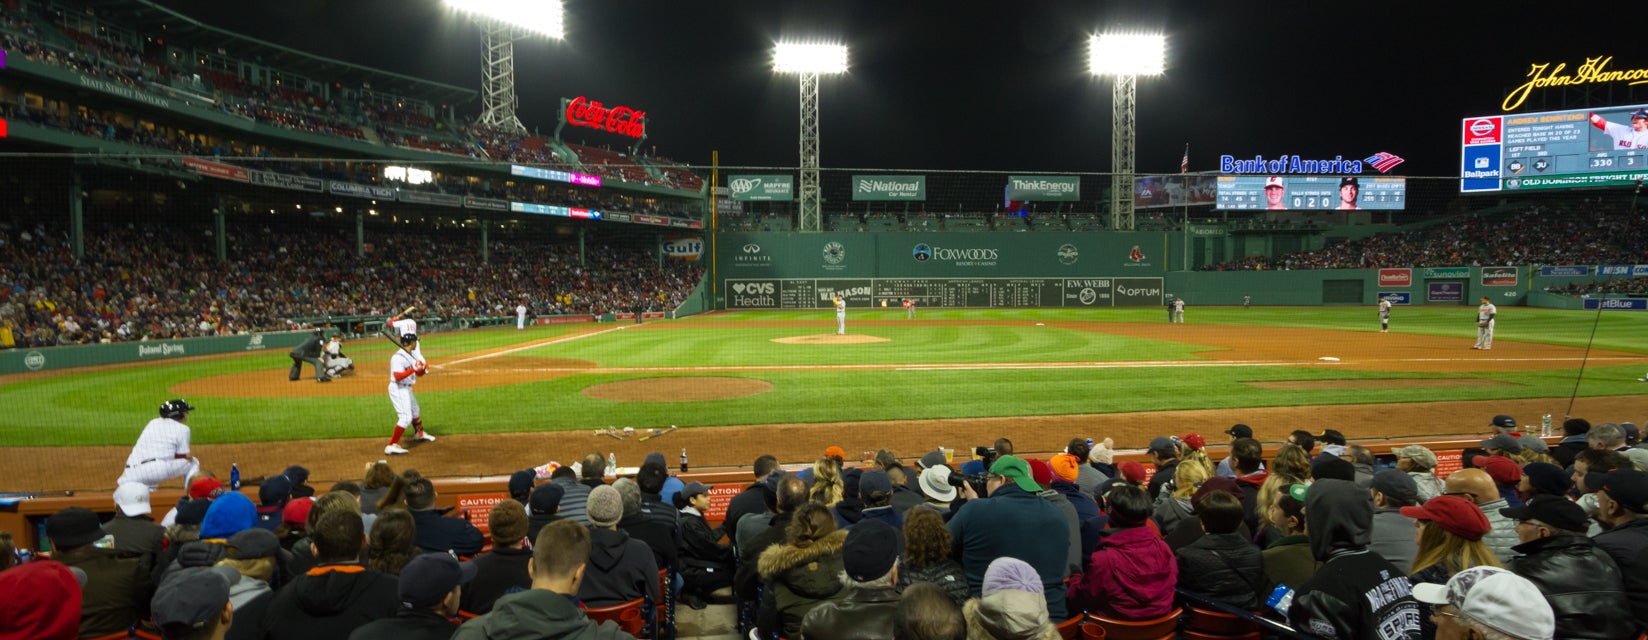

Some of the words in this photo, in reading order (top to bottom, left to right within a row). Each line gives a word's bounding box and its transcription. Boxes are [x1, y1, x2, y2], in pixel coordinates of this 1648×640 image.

[80, 76, 104, 90] STATE
[106, 83, 133, 98] STREET
[135, 92, 169, 108] PAVILION
[1502, 63, 1572, 111] John
[566, 96, 646, 138] Coca-Cola
[1221, 155, 1268, 174] Bank
[1269, 155, 1289, 174] of
[1289, 156, 1363, 174] America
[1590, 159, 1613, 168] .330
[1465, 170, 1499, 178] Ballpark
[732, 179, 752, 193] AAA
[872, 181, 919, 192] National
[1013, 180, 1074, 193] ThinkEnergy
[1542, 177, 1588, 185] DOMINION
[331, 183, 371, 194] COLUMBIA
[372, 188, 392, 197] TECH
[1294, 198, 1301, 207] 0
[1308, 198, 1315, 207] 2
[1322, 198, 1329, 207] 0
[663, 241, 702, 253] Gulf
[933, 247, 998, 260] FOXWOODS
[746, 283, 775, 294] CVS
[837, 286, 871, 298] MASON
[734, 295, 775, 306] Health
[139, 344, 162, 357] Poland
[162, 343, 185, 355] Spring
[1365, 586, 1388, 613] NBA
